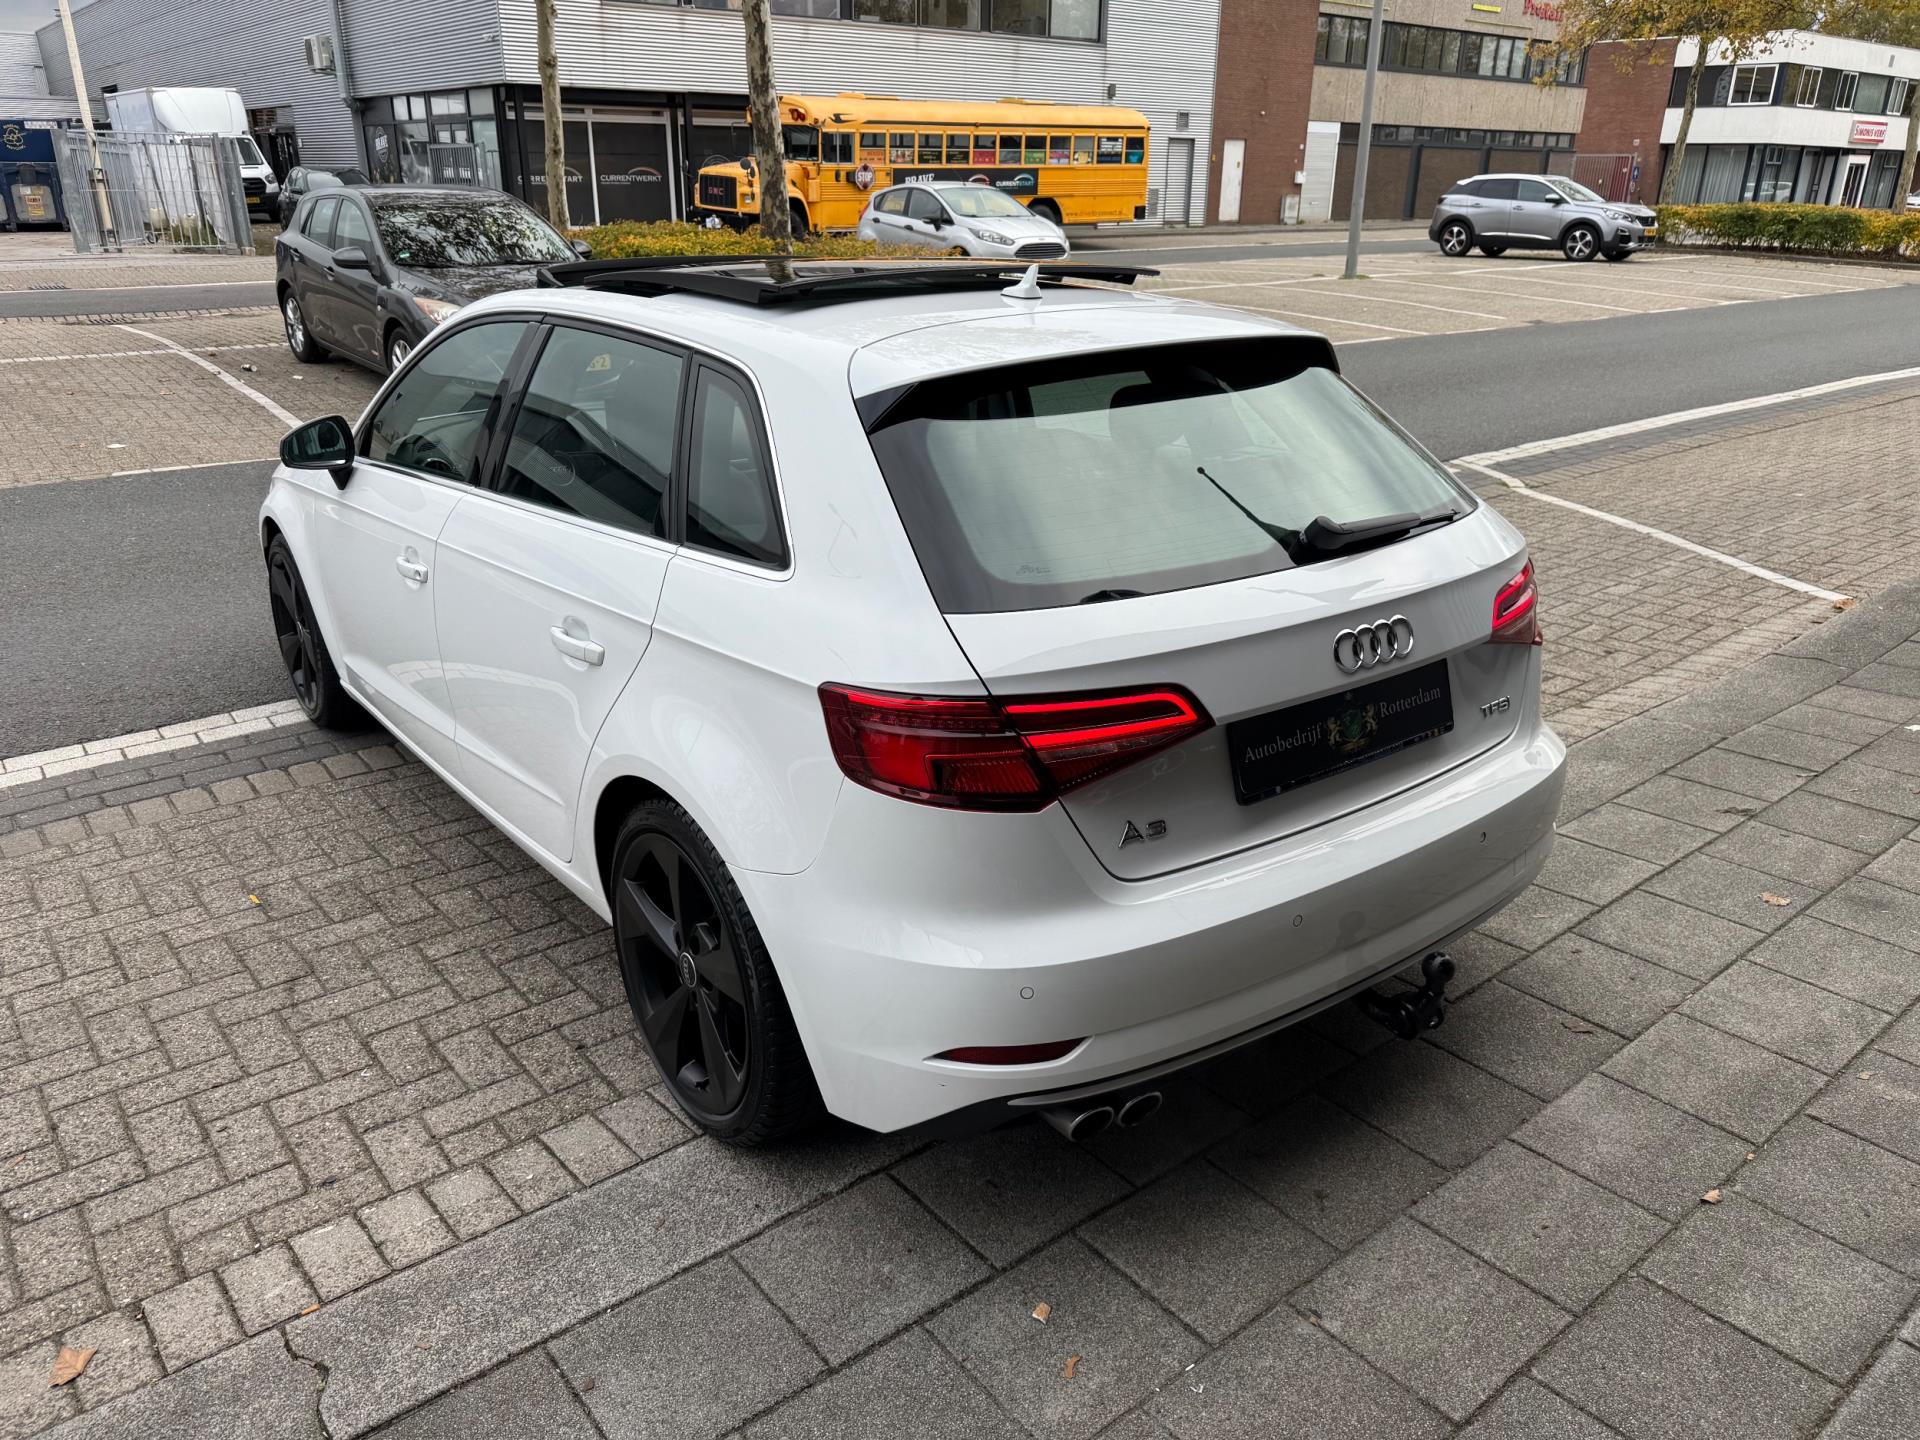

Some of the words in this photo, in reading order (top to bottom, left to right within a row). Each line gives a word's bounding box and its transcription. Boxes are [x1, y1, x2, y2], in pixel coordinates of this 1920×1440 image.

[600, 174, 663, 183] CURRENTWERKT
[857, 171, 873, 182] STOP
[707, 186, 725, 196] GMC
[1244, 722, 1323, 763] Autobedrijf
[1379, 687, 1441, 718] Rotterdam
[1118, 819, 1166, 849] A3
